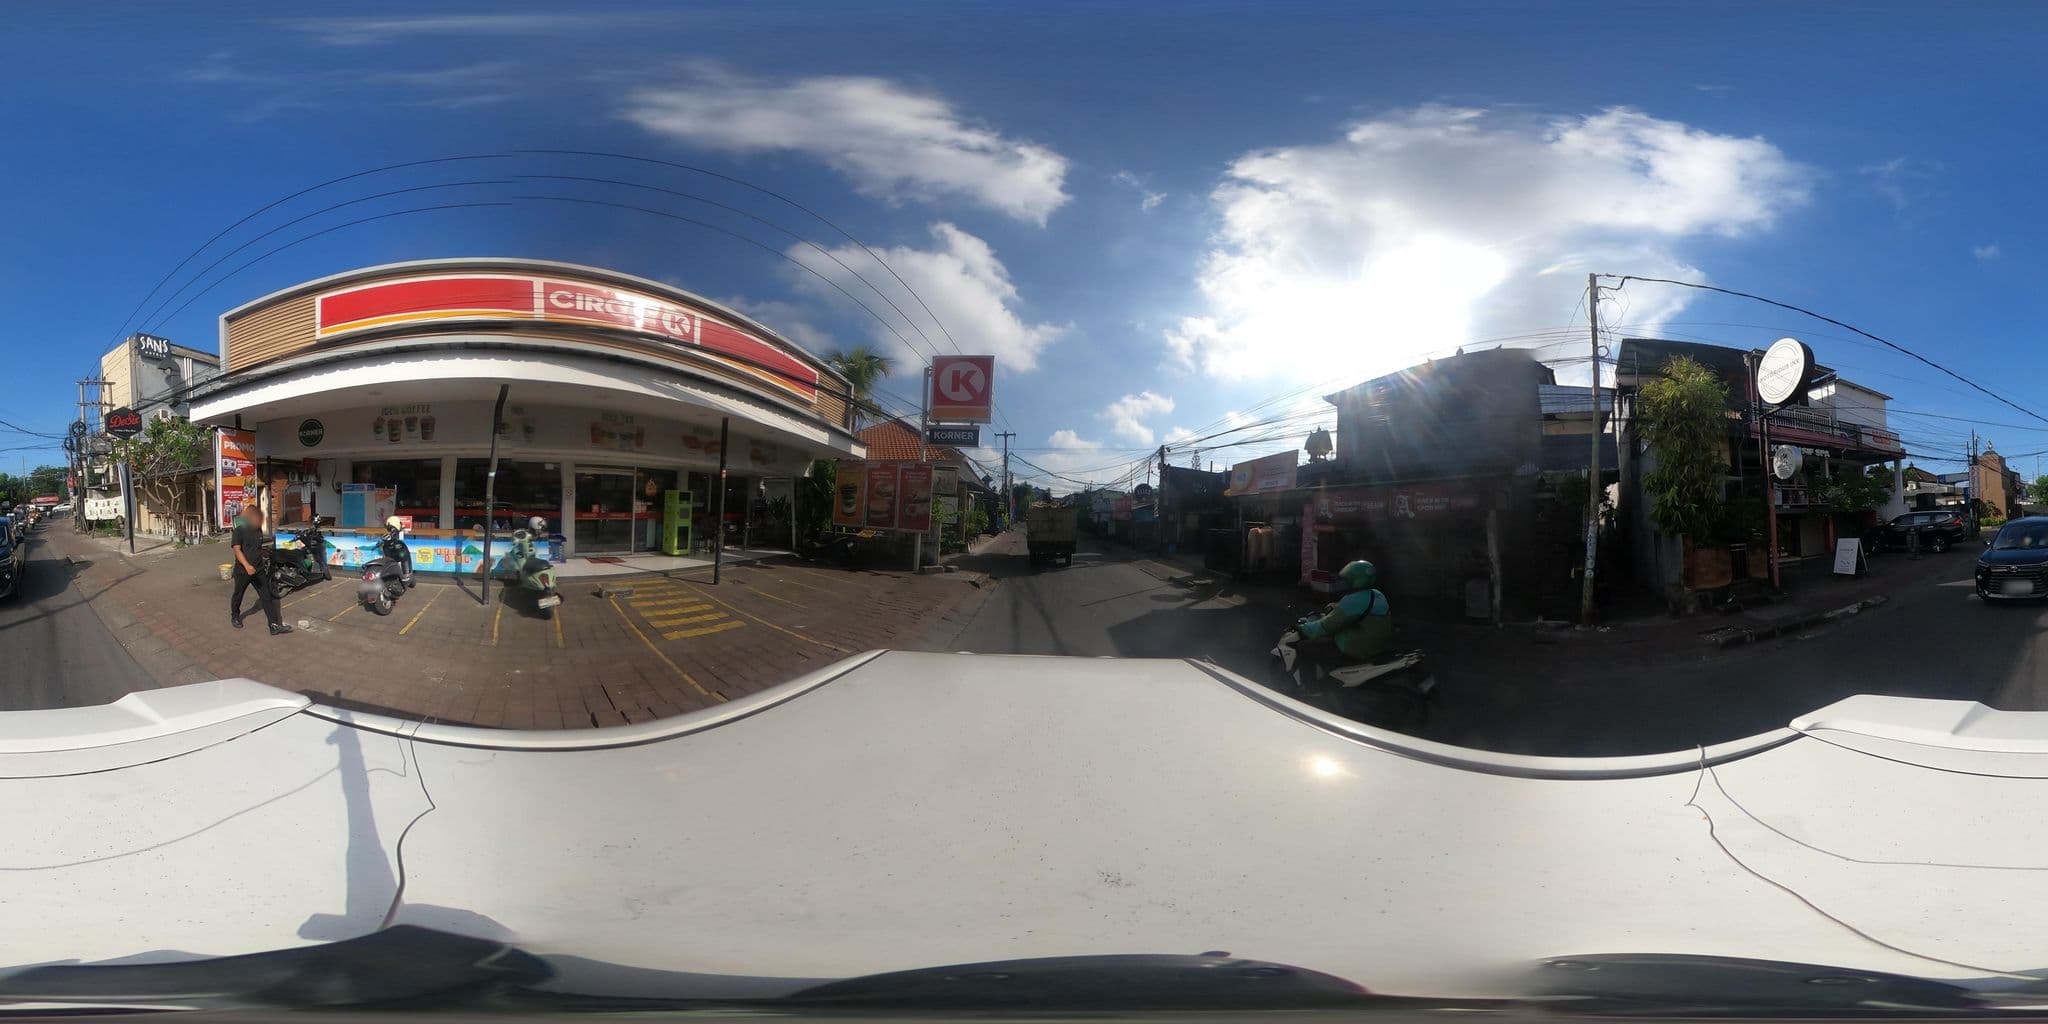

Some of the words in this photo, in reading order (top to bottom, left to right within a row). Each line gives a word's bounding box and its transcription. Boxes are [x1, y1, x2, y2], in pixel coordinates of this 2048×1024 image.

[549, 290, 660, 327] CIRCE
[140, 336, 168, 353] SANS
[223, 440, 255, 452] PROMO
